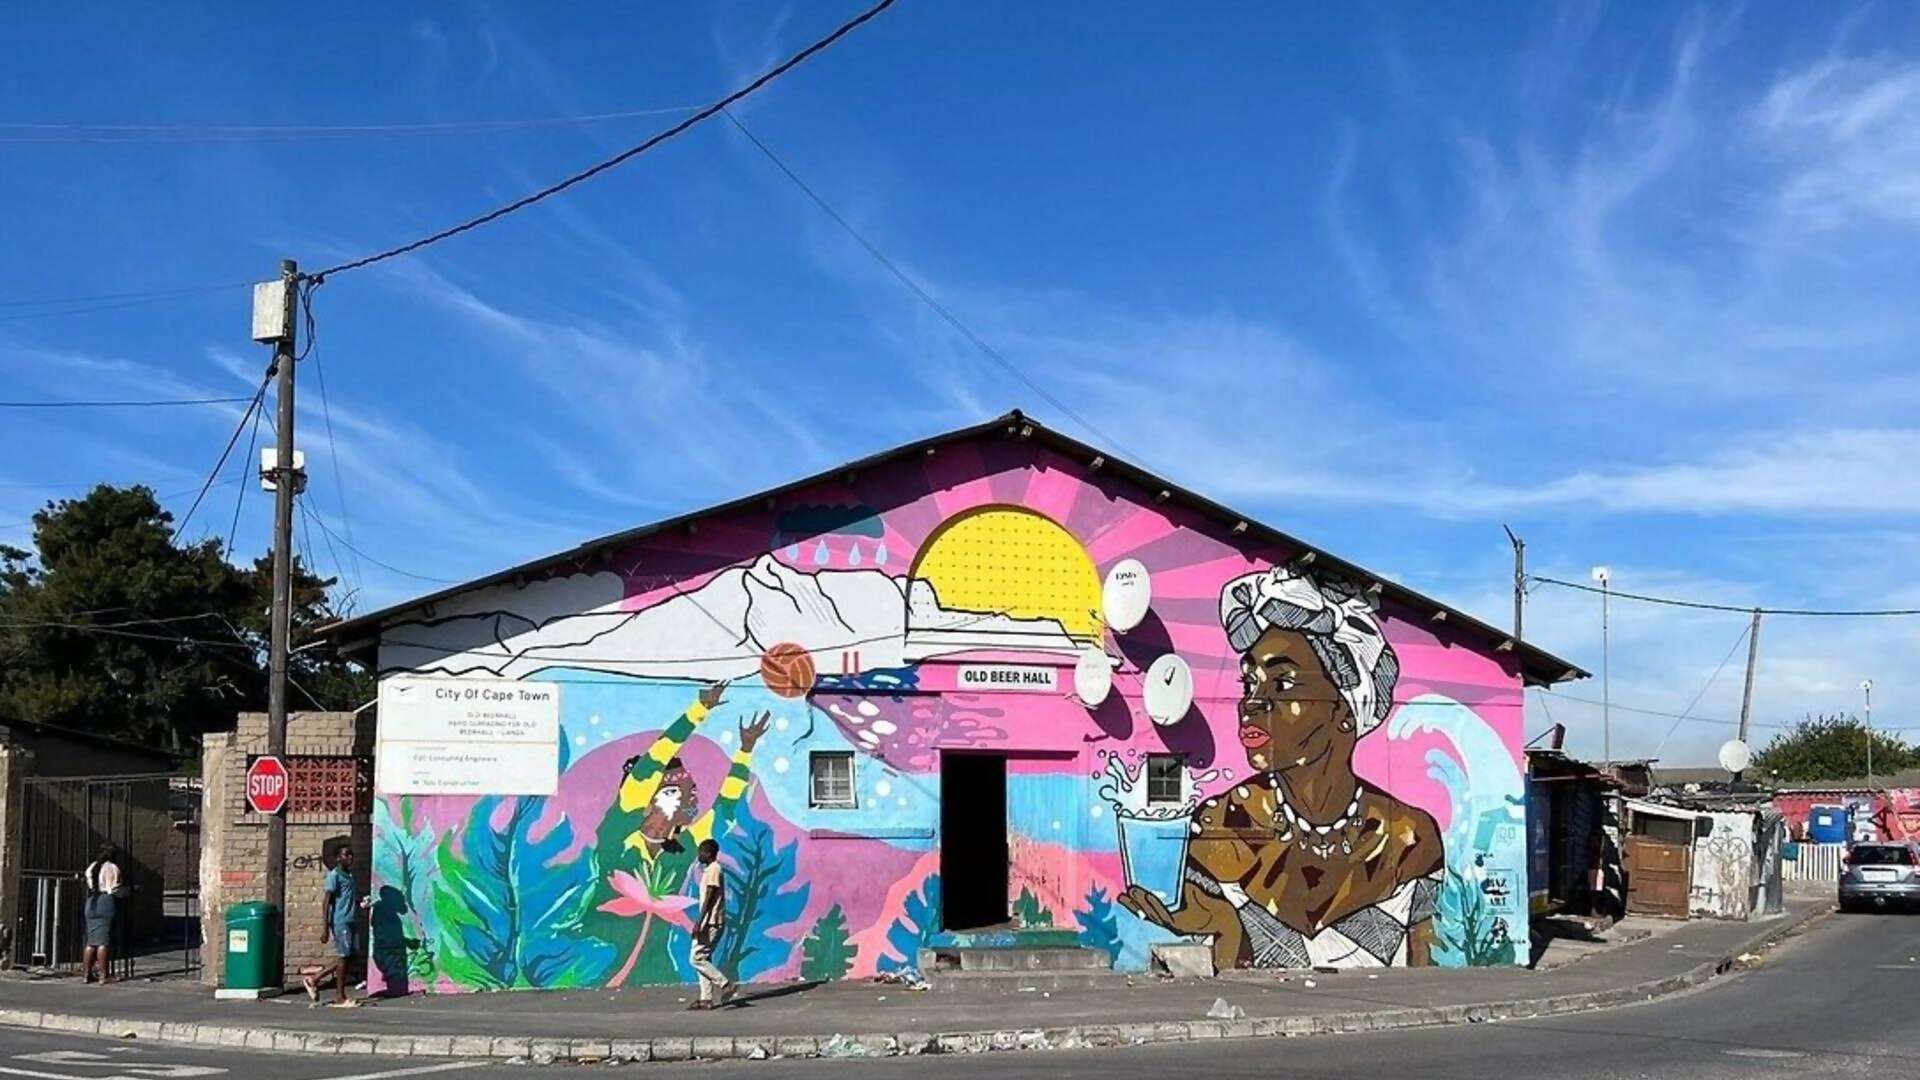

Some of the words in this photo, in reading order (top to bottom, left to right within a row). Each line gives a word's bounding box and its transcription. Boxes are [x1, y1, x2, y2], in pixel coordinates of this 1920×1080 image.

[964, 670, 987, 682] OLD
[990, 671, 1020, 683] BEER
[1023, 672, 1051, 684] HALL
[435, 688, 461, 701] City
[464, 688, 478, 700] Of
[482, 689, 514, 702] Cape
[519, 690, 550, 701] Town
[250, 774, 283, 796] STOP
